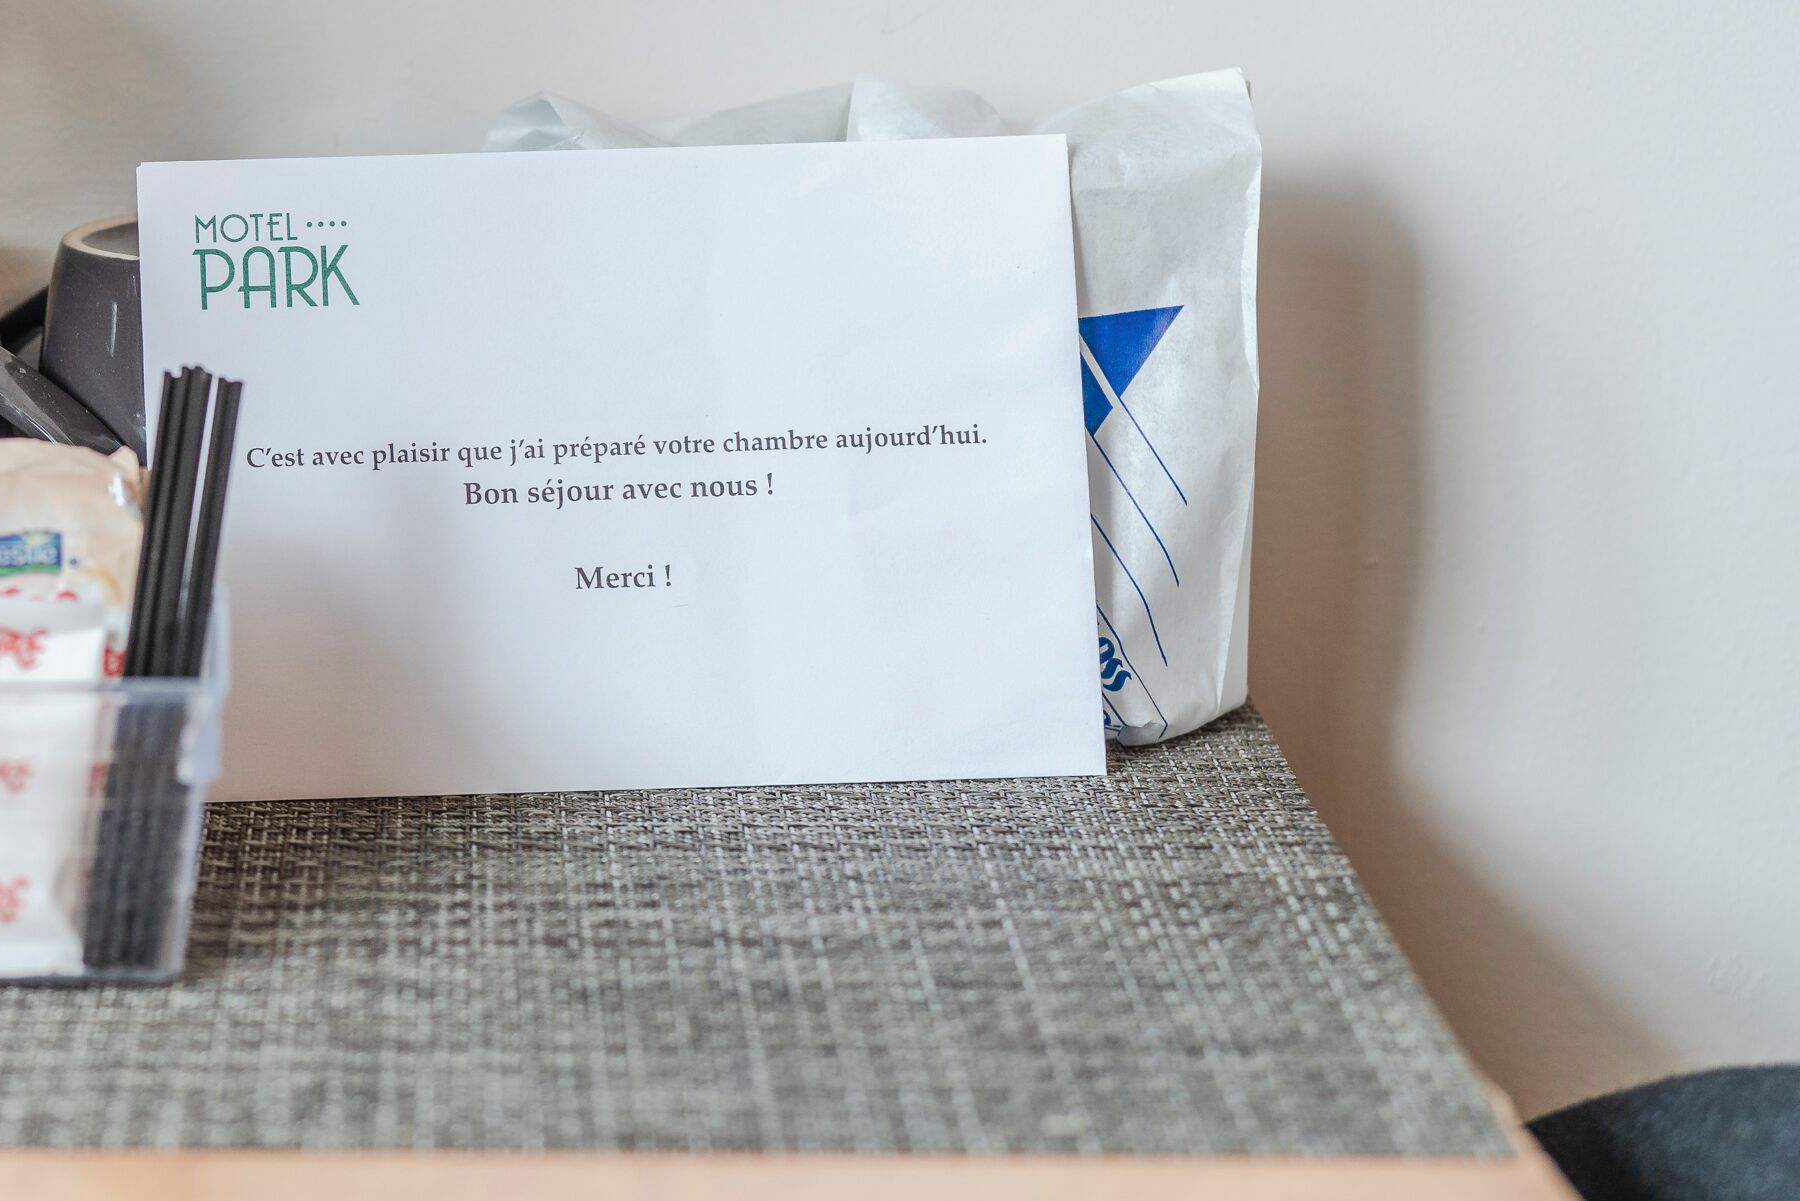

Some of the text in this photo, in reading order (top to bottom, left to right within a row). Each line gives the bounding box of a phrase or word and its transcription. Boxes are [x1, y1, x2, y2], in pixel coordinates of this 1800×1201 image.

[194, 213, 298, 244] MOTEL
[192, 245, 360, 310] PARK
[245, 423, 988, 471] C’est avec plaisir que j’ai préparé votre chambre aujourd’hui.
[463, 481, 519, 505] Bon
[526, 477, 615, 510] séjour
[621, 481, 683, 501] avec
[689, 477, 758, 498] nous
[574, 564, 656, 591] Merci
